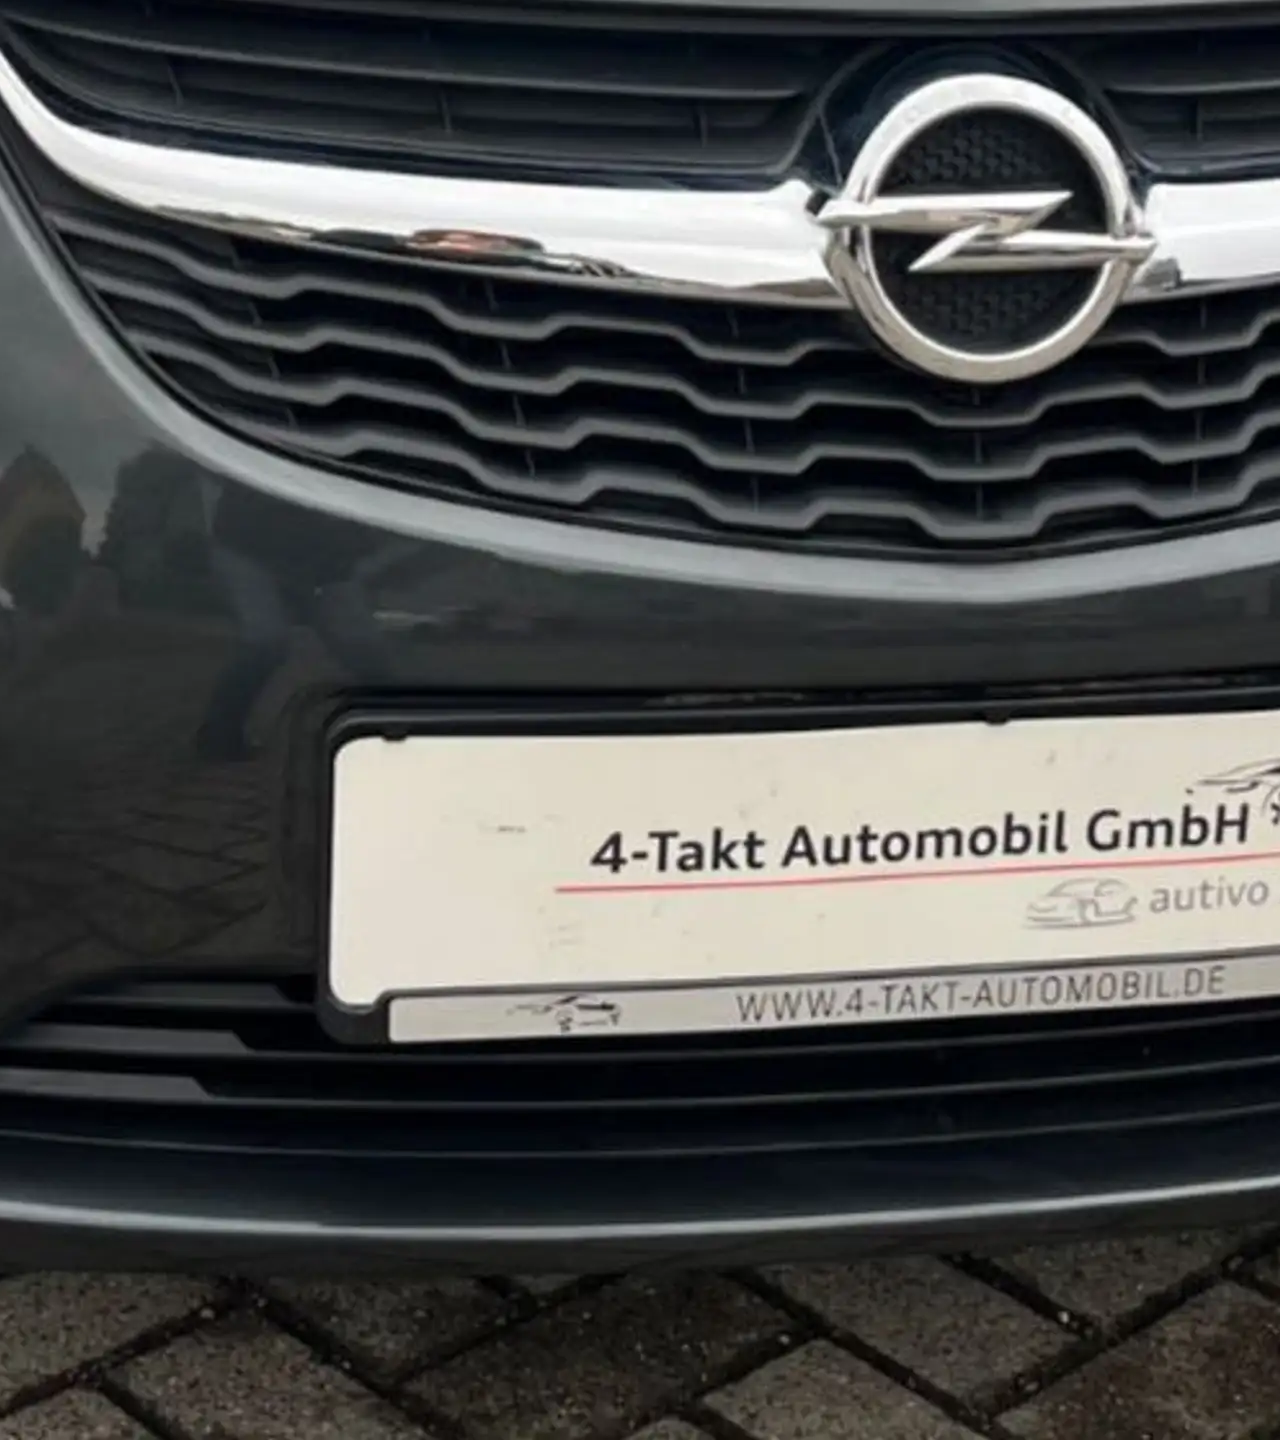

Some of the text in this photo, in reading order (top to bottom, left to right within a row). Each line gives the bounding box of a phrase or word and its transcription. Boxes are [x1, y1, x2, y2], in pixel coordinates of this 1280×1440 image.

[589, 801, 1251, 874] 4-Takt Automobil GmbH
[1147, 874, 1271, 915] autivo
[734, 964, 1227, 1024] WWW.4-TAKT-AUTOMOBIL.DE
